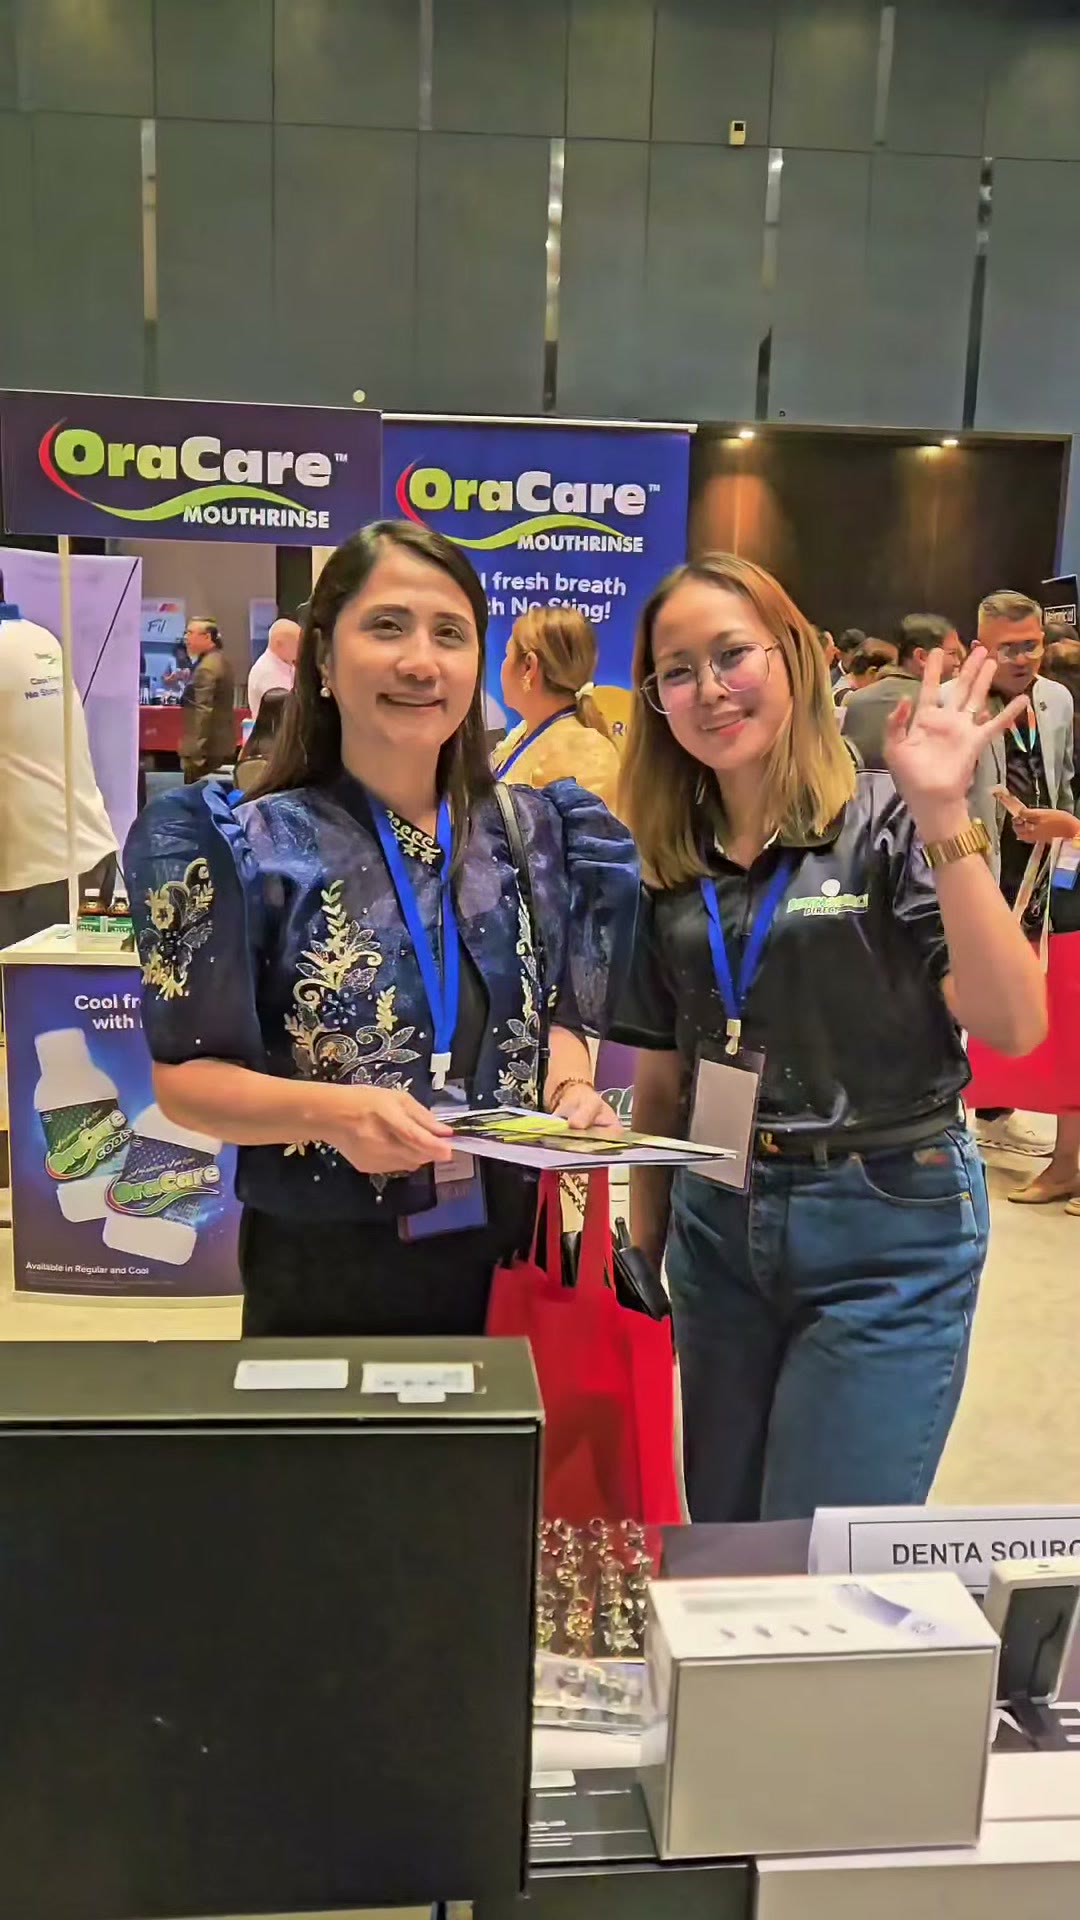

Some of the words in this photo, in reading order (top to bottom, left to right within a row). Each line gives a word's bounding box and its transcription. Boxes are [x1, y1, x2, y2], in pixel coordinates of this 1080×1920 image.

[54, 428, 332, 488] OraCare
[409, 467, 646, 515] OraCare
[183, 505, 330, 529] MOUTHRINSE
[517, 533, 643, 553] MOUTHRINSE
[492, 571, 549, 591] fresh
[555, 572, 626, 596] breath
[74, 993, 118, 1010] Cool
[92, 1013, 134, 1030] with
[25, 1261, 64, 1272] Available
[65, 1263, 73, 1272] in
[74, 1264, 108, 1275] Regular
[110, 1267, 127, 1275] and
[128, 1266, 149, 1275] Cool
[892, 1541, 983, 1566] DENTA
